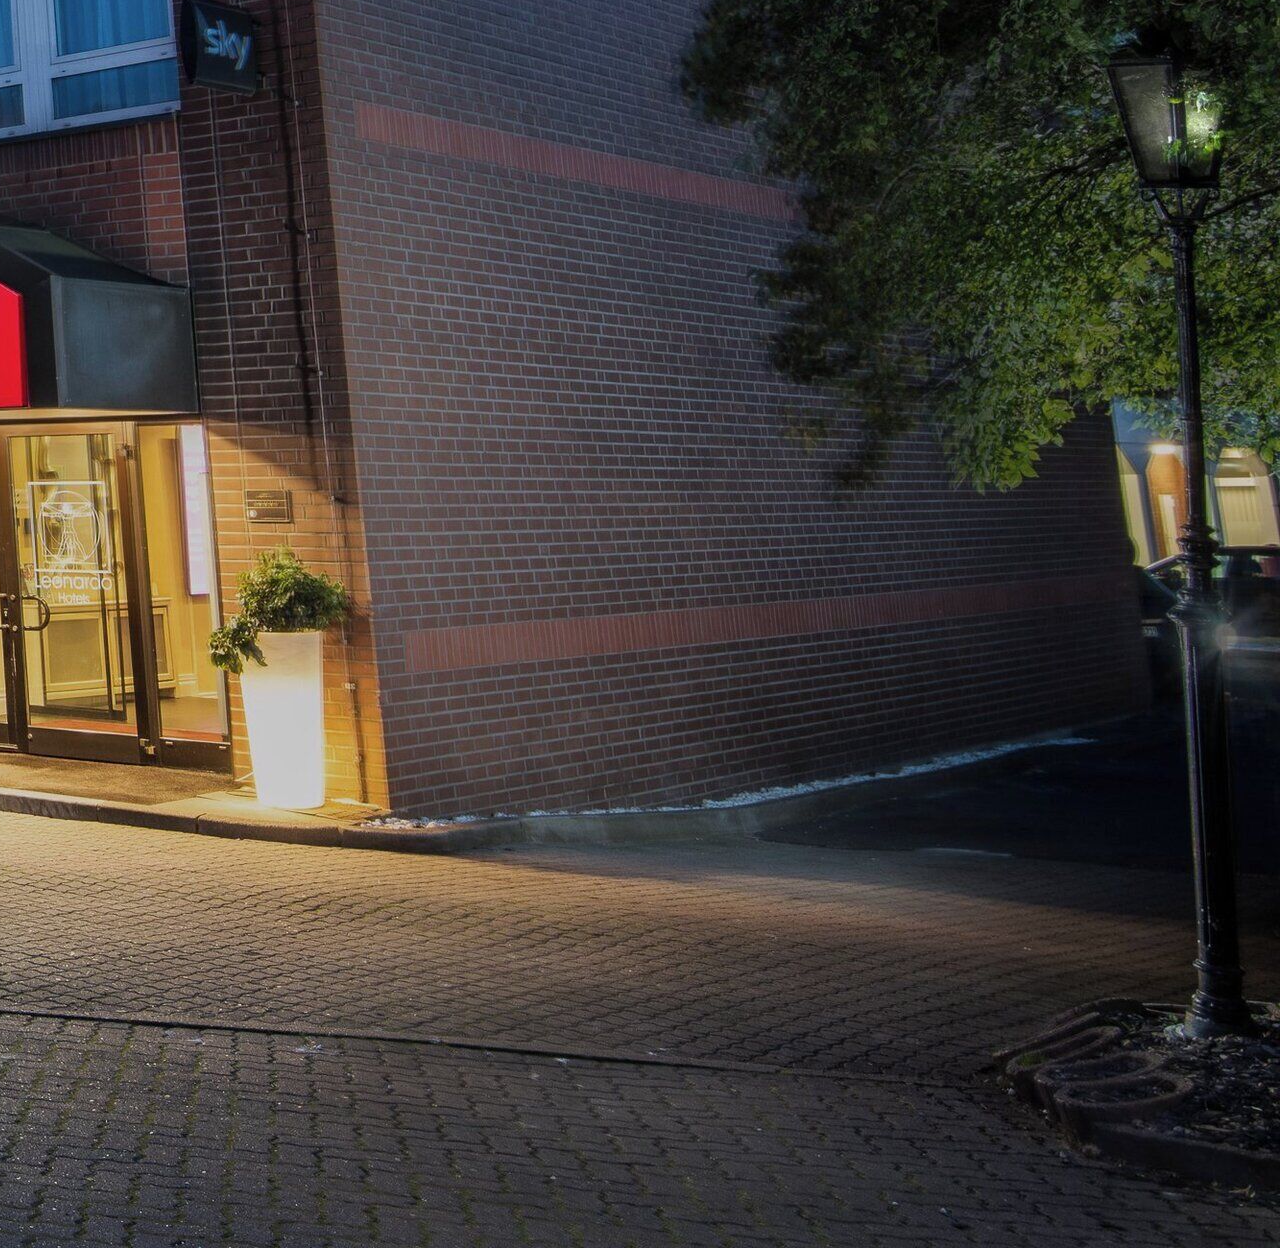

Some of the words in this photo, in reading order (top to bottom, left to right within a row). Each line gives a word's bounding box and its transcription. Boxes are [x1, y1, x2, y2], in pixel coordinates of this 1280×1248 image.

[204, 19, 252, 71] sky
[34, 574, 114, 590] Leonardo
[58, 592, 90, 604] Hotels
